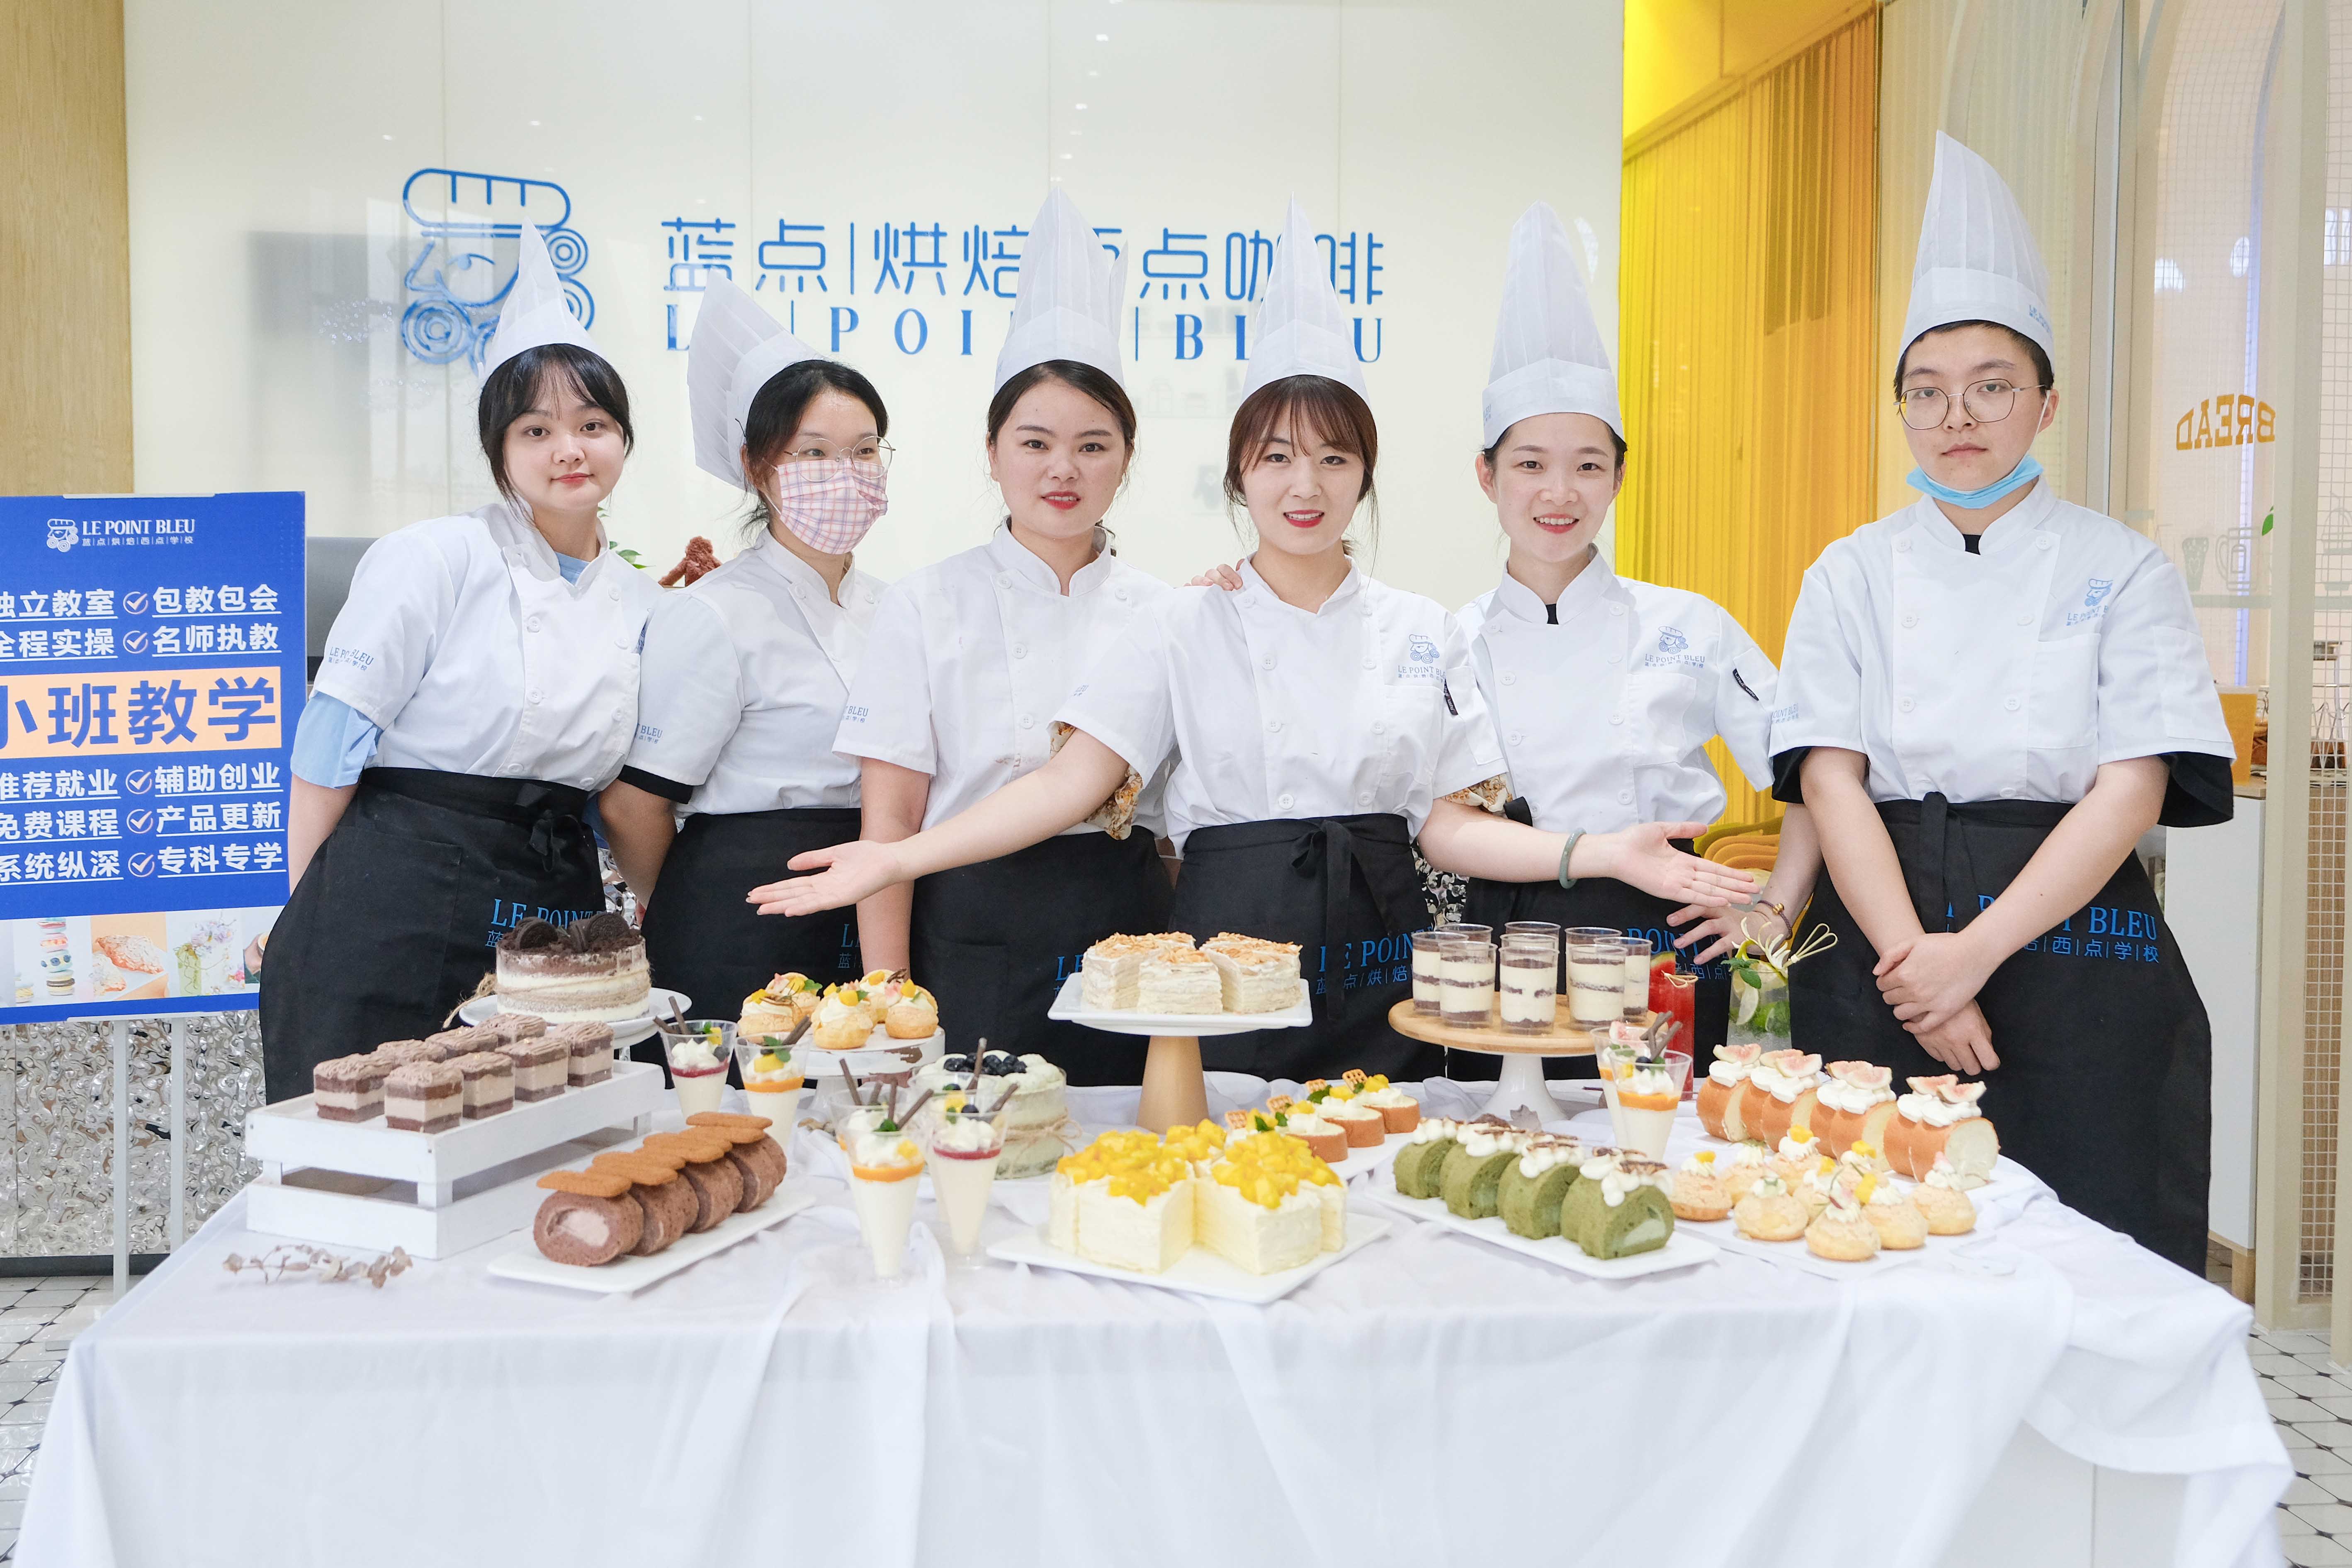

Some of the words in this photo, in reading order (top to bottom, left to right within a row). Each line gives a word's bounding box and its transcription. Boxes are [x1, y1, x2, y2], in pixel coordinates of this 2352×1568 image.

[830, 306, 1014, 356] POI
[1174, 313, 1383, 363] BLU
[83, 520, 101, 535] LE
[105, 519, 153, 535] POINT
[155, 518, 196, 534] BLEU
[152, 583, 279, 614] 包教包会
[152, 622, 279, 653] 名师执教
[1398, 665, 1407, 673] LE
[1645, 653, 1654, 662] LE
[1656, 655, 1681, 663] POINT
[1684, 655, 1705, 663] BLEU
[848, 706, 869, 717] BLEU
[640, 725, 663, 738] BLEU
[154, 762, 280, 794] 辅助创业
[0, 808, 119, 841] 免费课程
[156, 801, 282, 834] 产品更新
[0, 850, 120, 882] 系统纵深
[157, 842, 283, 874] 专科专学
[2088, 906, 2157, 940] BLEU
